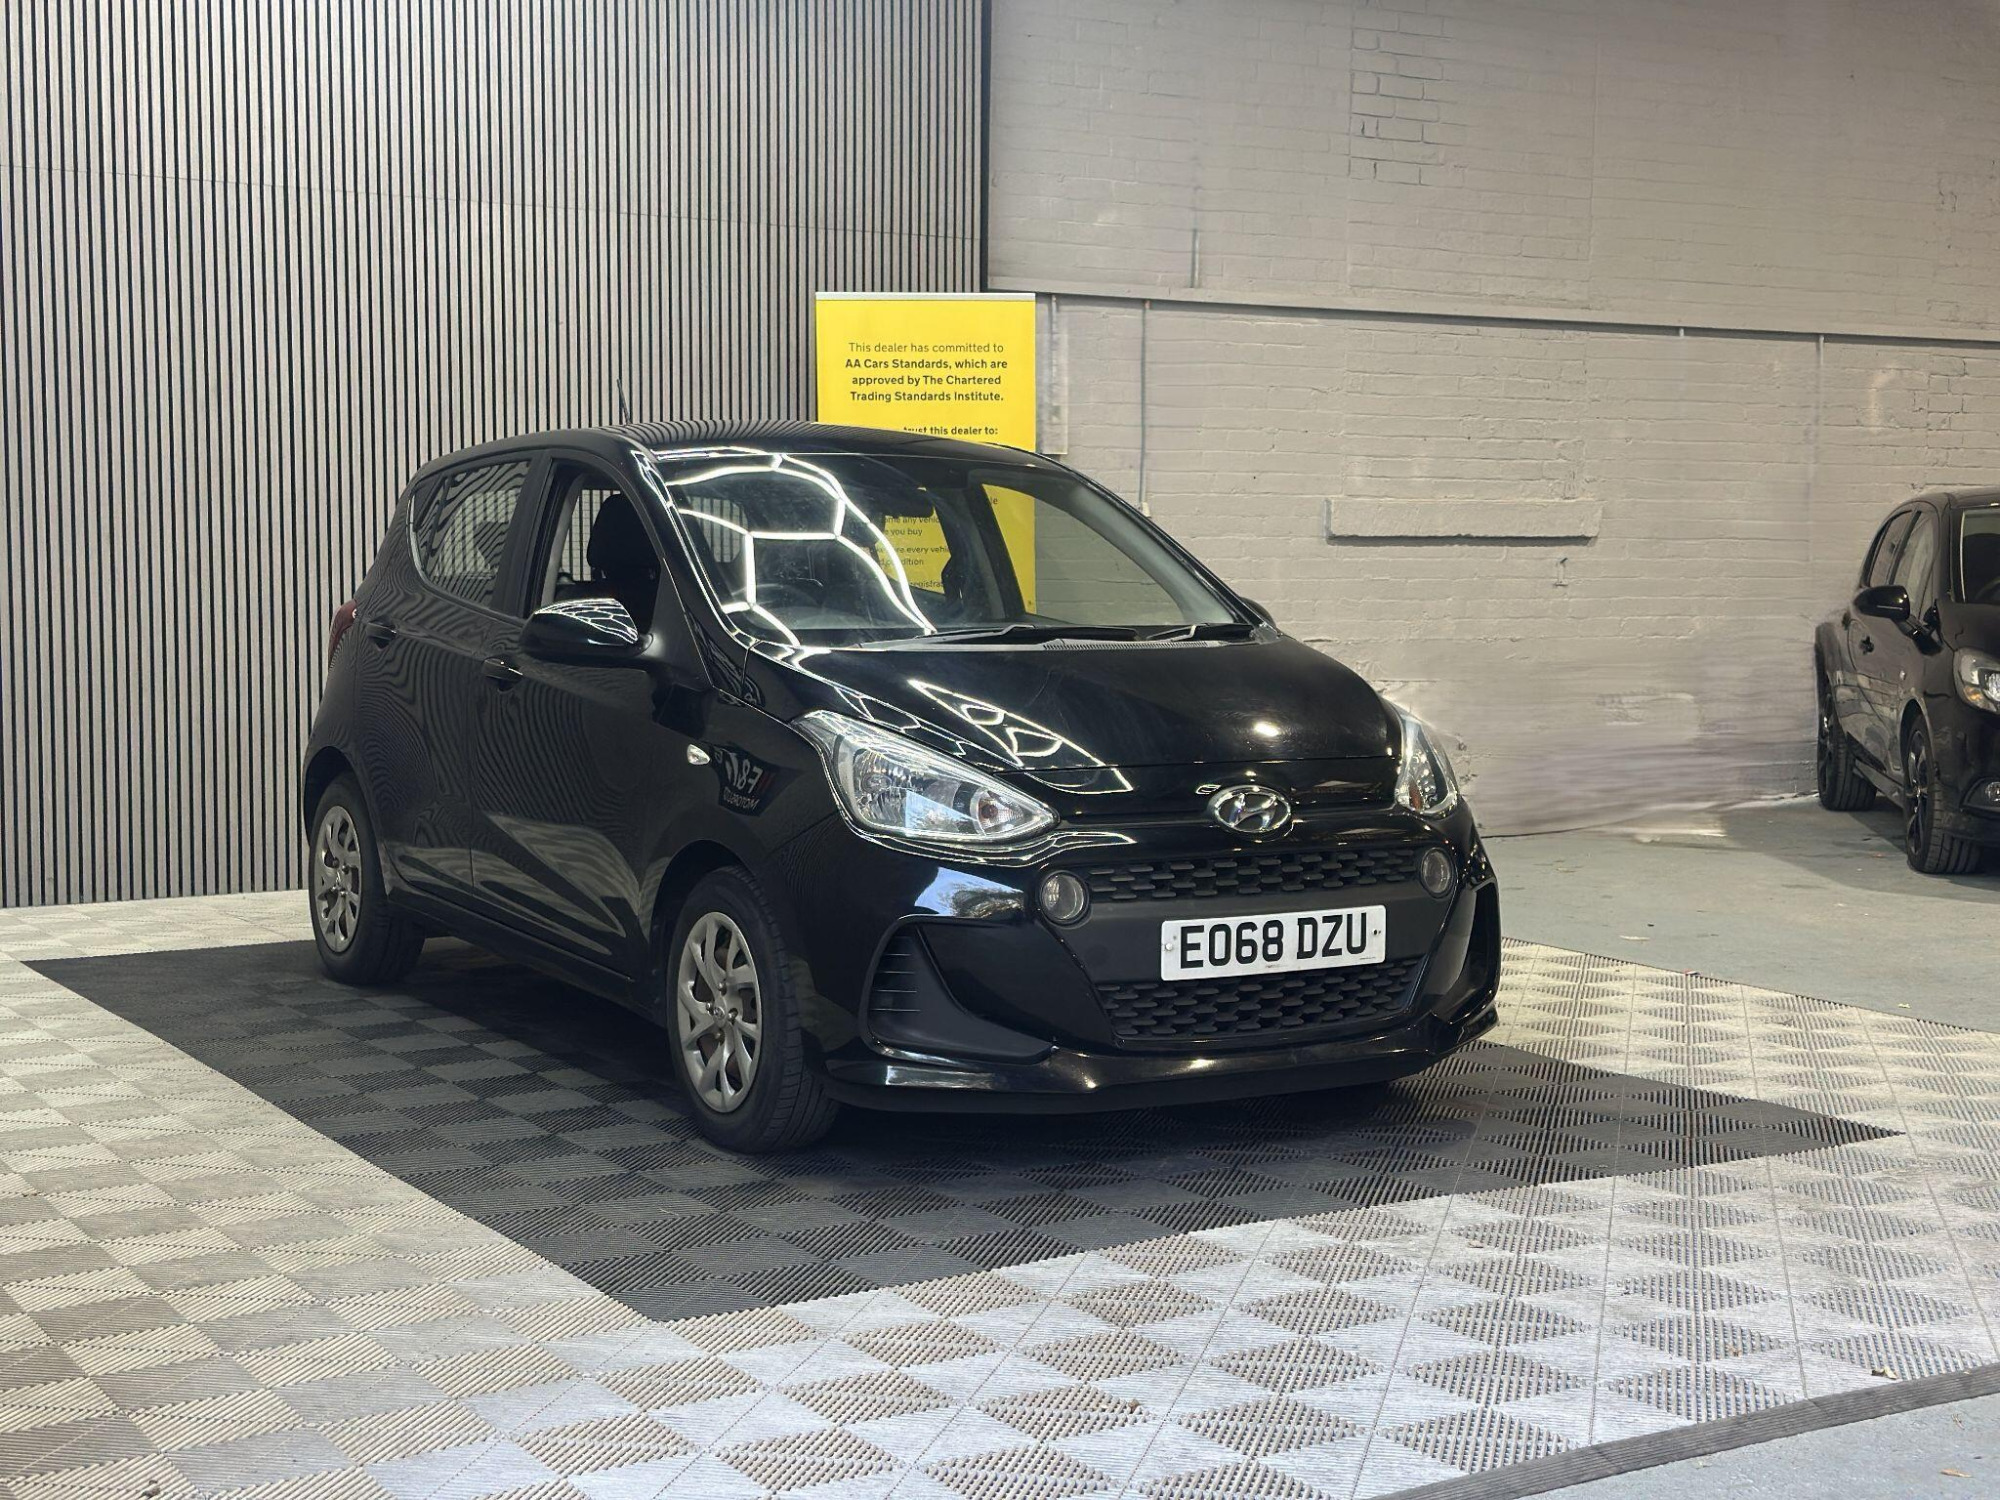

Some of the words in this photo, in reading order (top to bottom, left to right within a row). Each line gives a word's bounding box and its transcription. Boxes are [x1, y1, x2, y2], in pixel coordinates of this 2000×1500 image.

[848, 342, 871, 352] This
[874, 342, 907, 352] dealer
[910, 343, 929, 352] has
[932, 343, 990, 353] committed
[993, 344, 1004, 353] to
[845, 359, 861, 368] AA
[864, 359, 889, 368] Cars
[892, 359, 952, 370] Standards,
[955, 359, 987, 368] which
[990, 360, 1008, 369] are
[852, 375, 904, 386] approved
[907, 375, 921, 386] by
[922, 375, 943, 384] The
[946, 375, 1001, 384] Chartered
[850, 391, 891, 403] Trading
[894, 391, 951, 401] Standards
[954, 391, 1004, 401] Institute.
[930, 426, 948, 435] this
[951, 426, 982, 435] dealer
[984, 426, 998, 435] to:
[891, 529, 906, 537] you
[907, 528, 923, 537] buy
[906, 546, 928, 554] every
[1296, 912, 1367, 960] DZU
